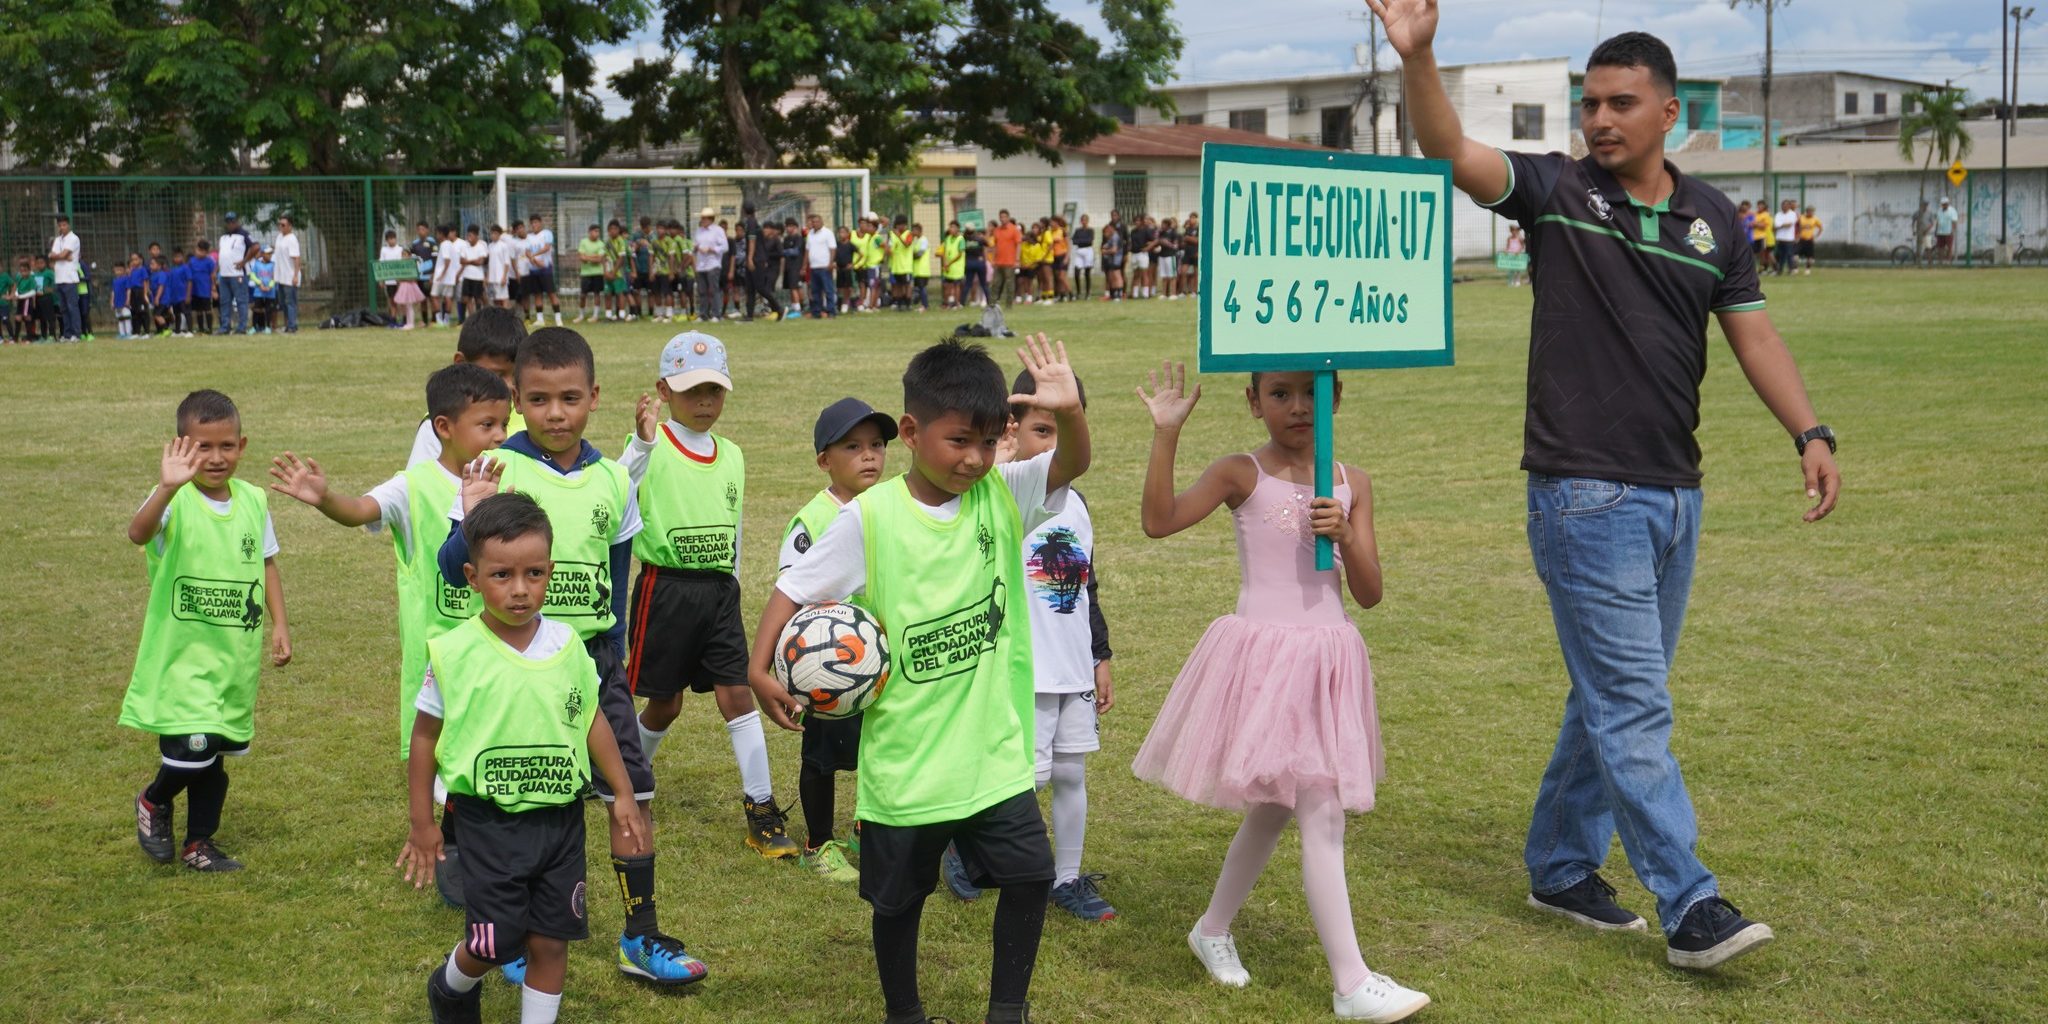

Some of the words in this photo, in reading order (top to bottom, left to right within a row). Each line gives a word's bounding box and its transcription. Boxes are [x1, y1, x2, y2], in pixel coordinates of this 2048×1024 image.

[1223, 279, 1241, 324] 4
[1255, 278, 1274, 325] 5
[1286, 279, 1303, 323] 6
[550, 571, 591, 582] CTURA
[181, 584, 243, 598] PREFECTURA
[546, 583, 591, 594] ADANA
[180, 592, 242, 609] CIUDADANA
[444, 599, 465, 610] DEL
[180, 603, 201, 614] DEL
[203, 608, 241, 619] GUAYAS
[907, 610, 990, 649] PREFECTURA
[911, 626, 986, 659] CIUDADAN
[912, 656, 945, 673] DEL
[947, 641, 983, 664] GUAY
[485, 755, 574, 770] PREFECTURA
[484, 767, 573, 782] CIUDADANA
[485, 783, 515, 796] DEL
[518, 781, 573, 795] GUAYAS
